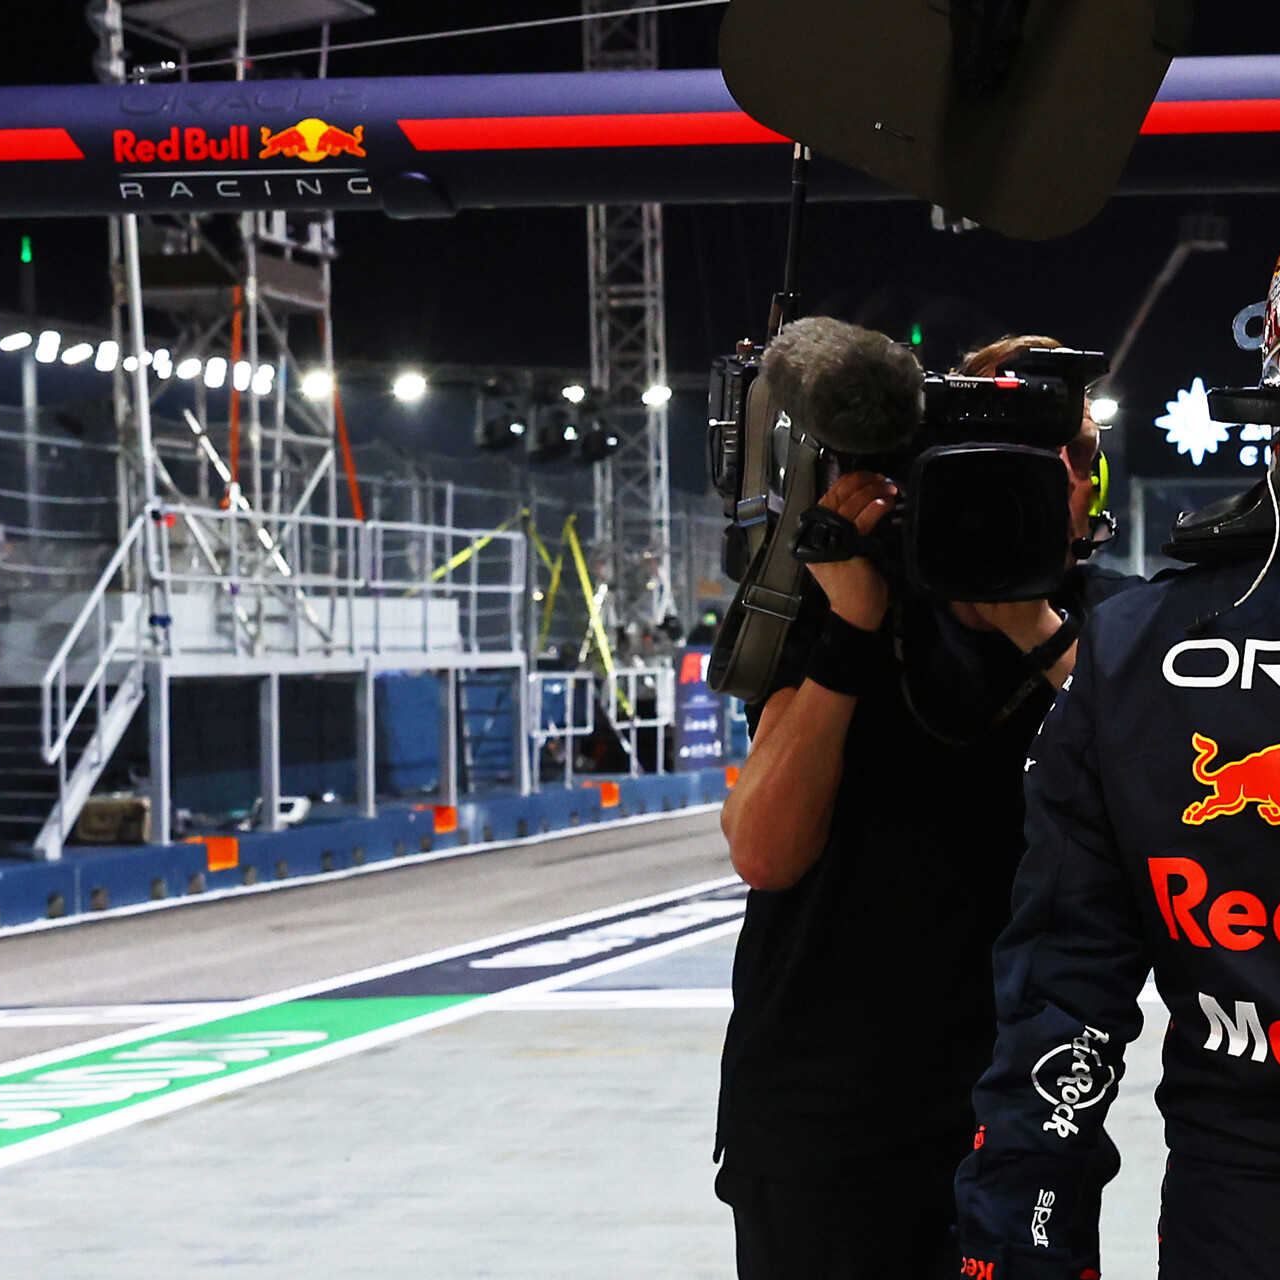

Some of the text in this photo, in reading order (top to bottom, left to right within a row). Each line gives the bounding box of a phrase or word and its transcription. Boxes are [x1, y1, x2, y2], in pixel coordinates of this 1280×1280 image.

[113, 125, 249, 162] Red Bull
[120, 178, 372, 199] RACING
[949, 381, 978, 389] SONY
